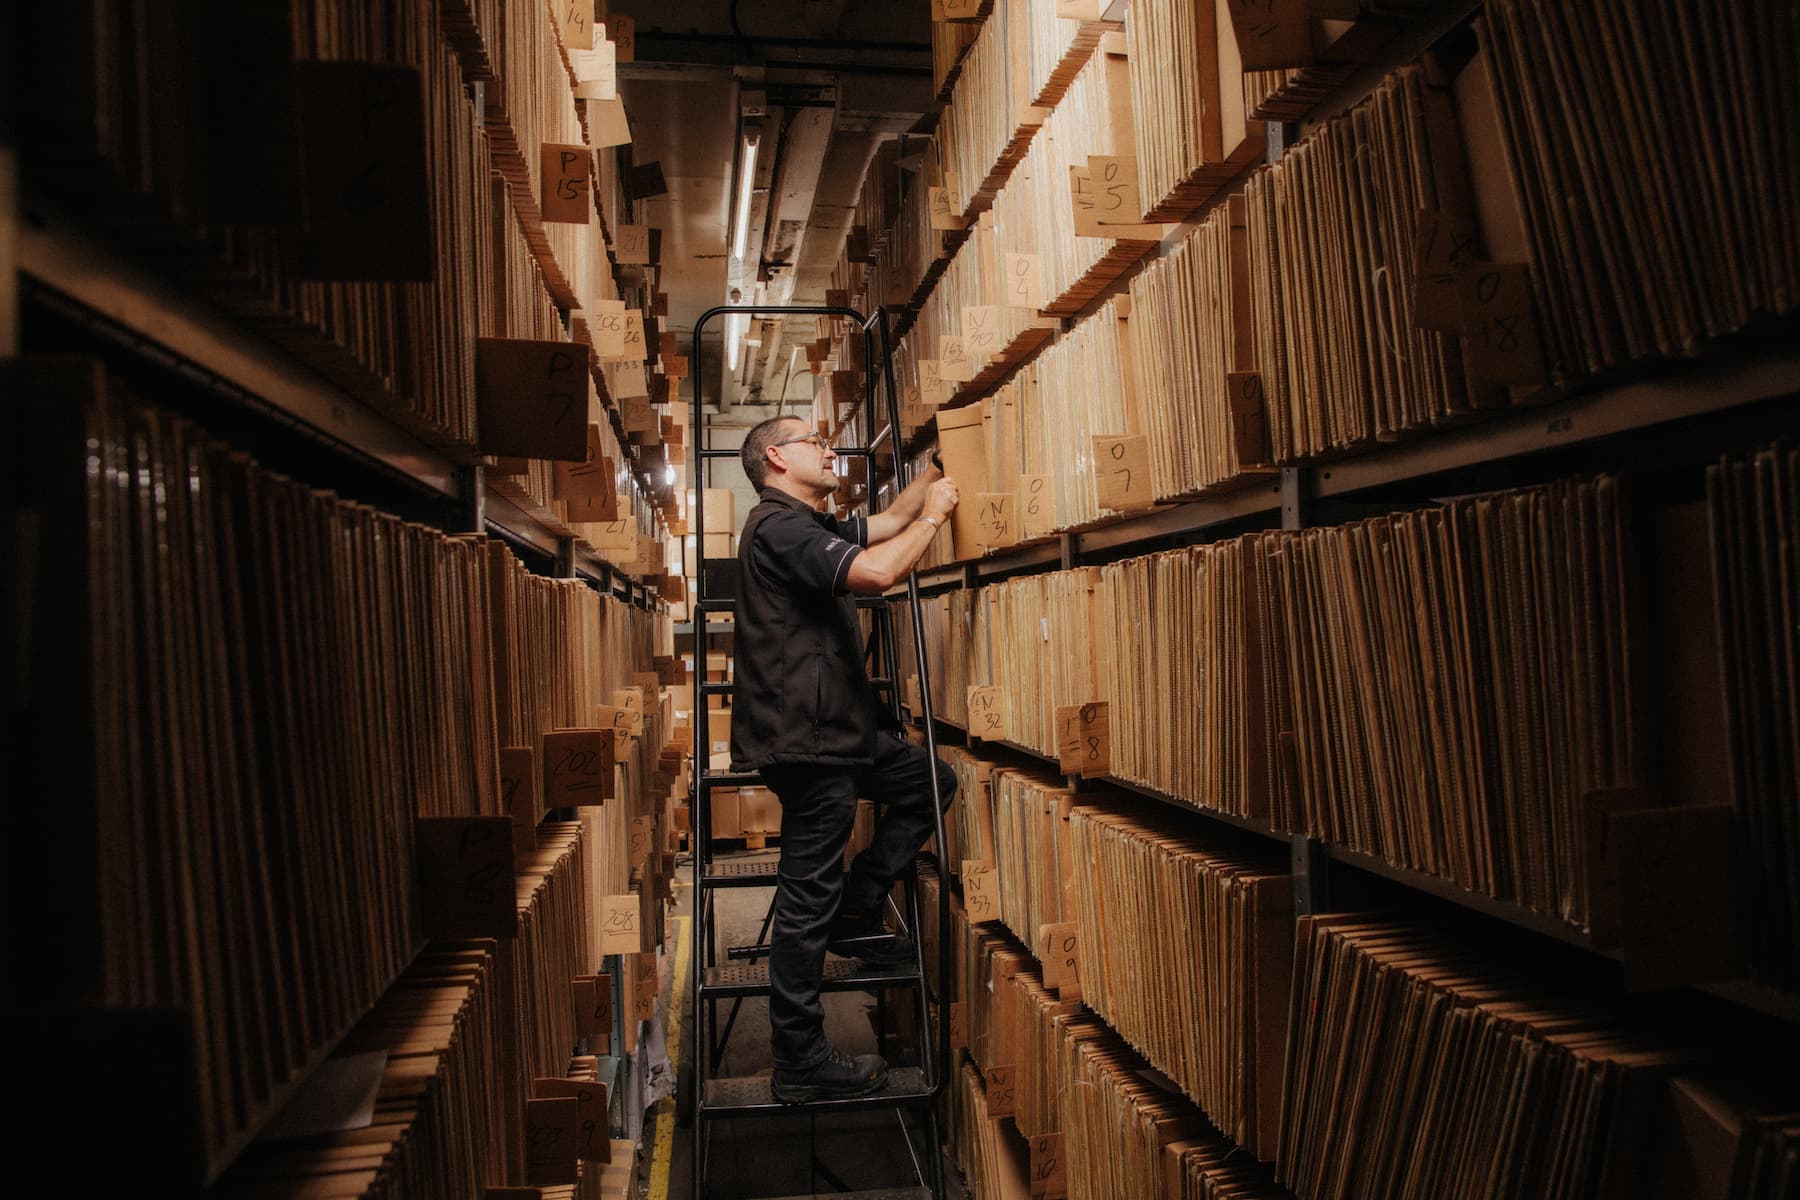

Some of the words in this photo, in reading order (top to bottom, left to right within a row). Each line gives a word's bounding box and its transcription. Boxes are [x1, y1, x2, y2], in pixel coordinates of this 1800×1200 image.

[561, 151, 577, 173] P
[556, 178, 584, 200] 15
[1105, 184, 1129, 210] 5
[1113, 468, 1131, 493] 7
[992, 499, 1005, 517] N
[1027, 500, 1040, 515] 6
[982, 695, 994, 710] N
[1088, 735, 1099, 761] 8
[969, 877, 982, 891] N
[1066, 958, 1079, 984] 9
